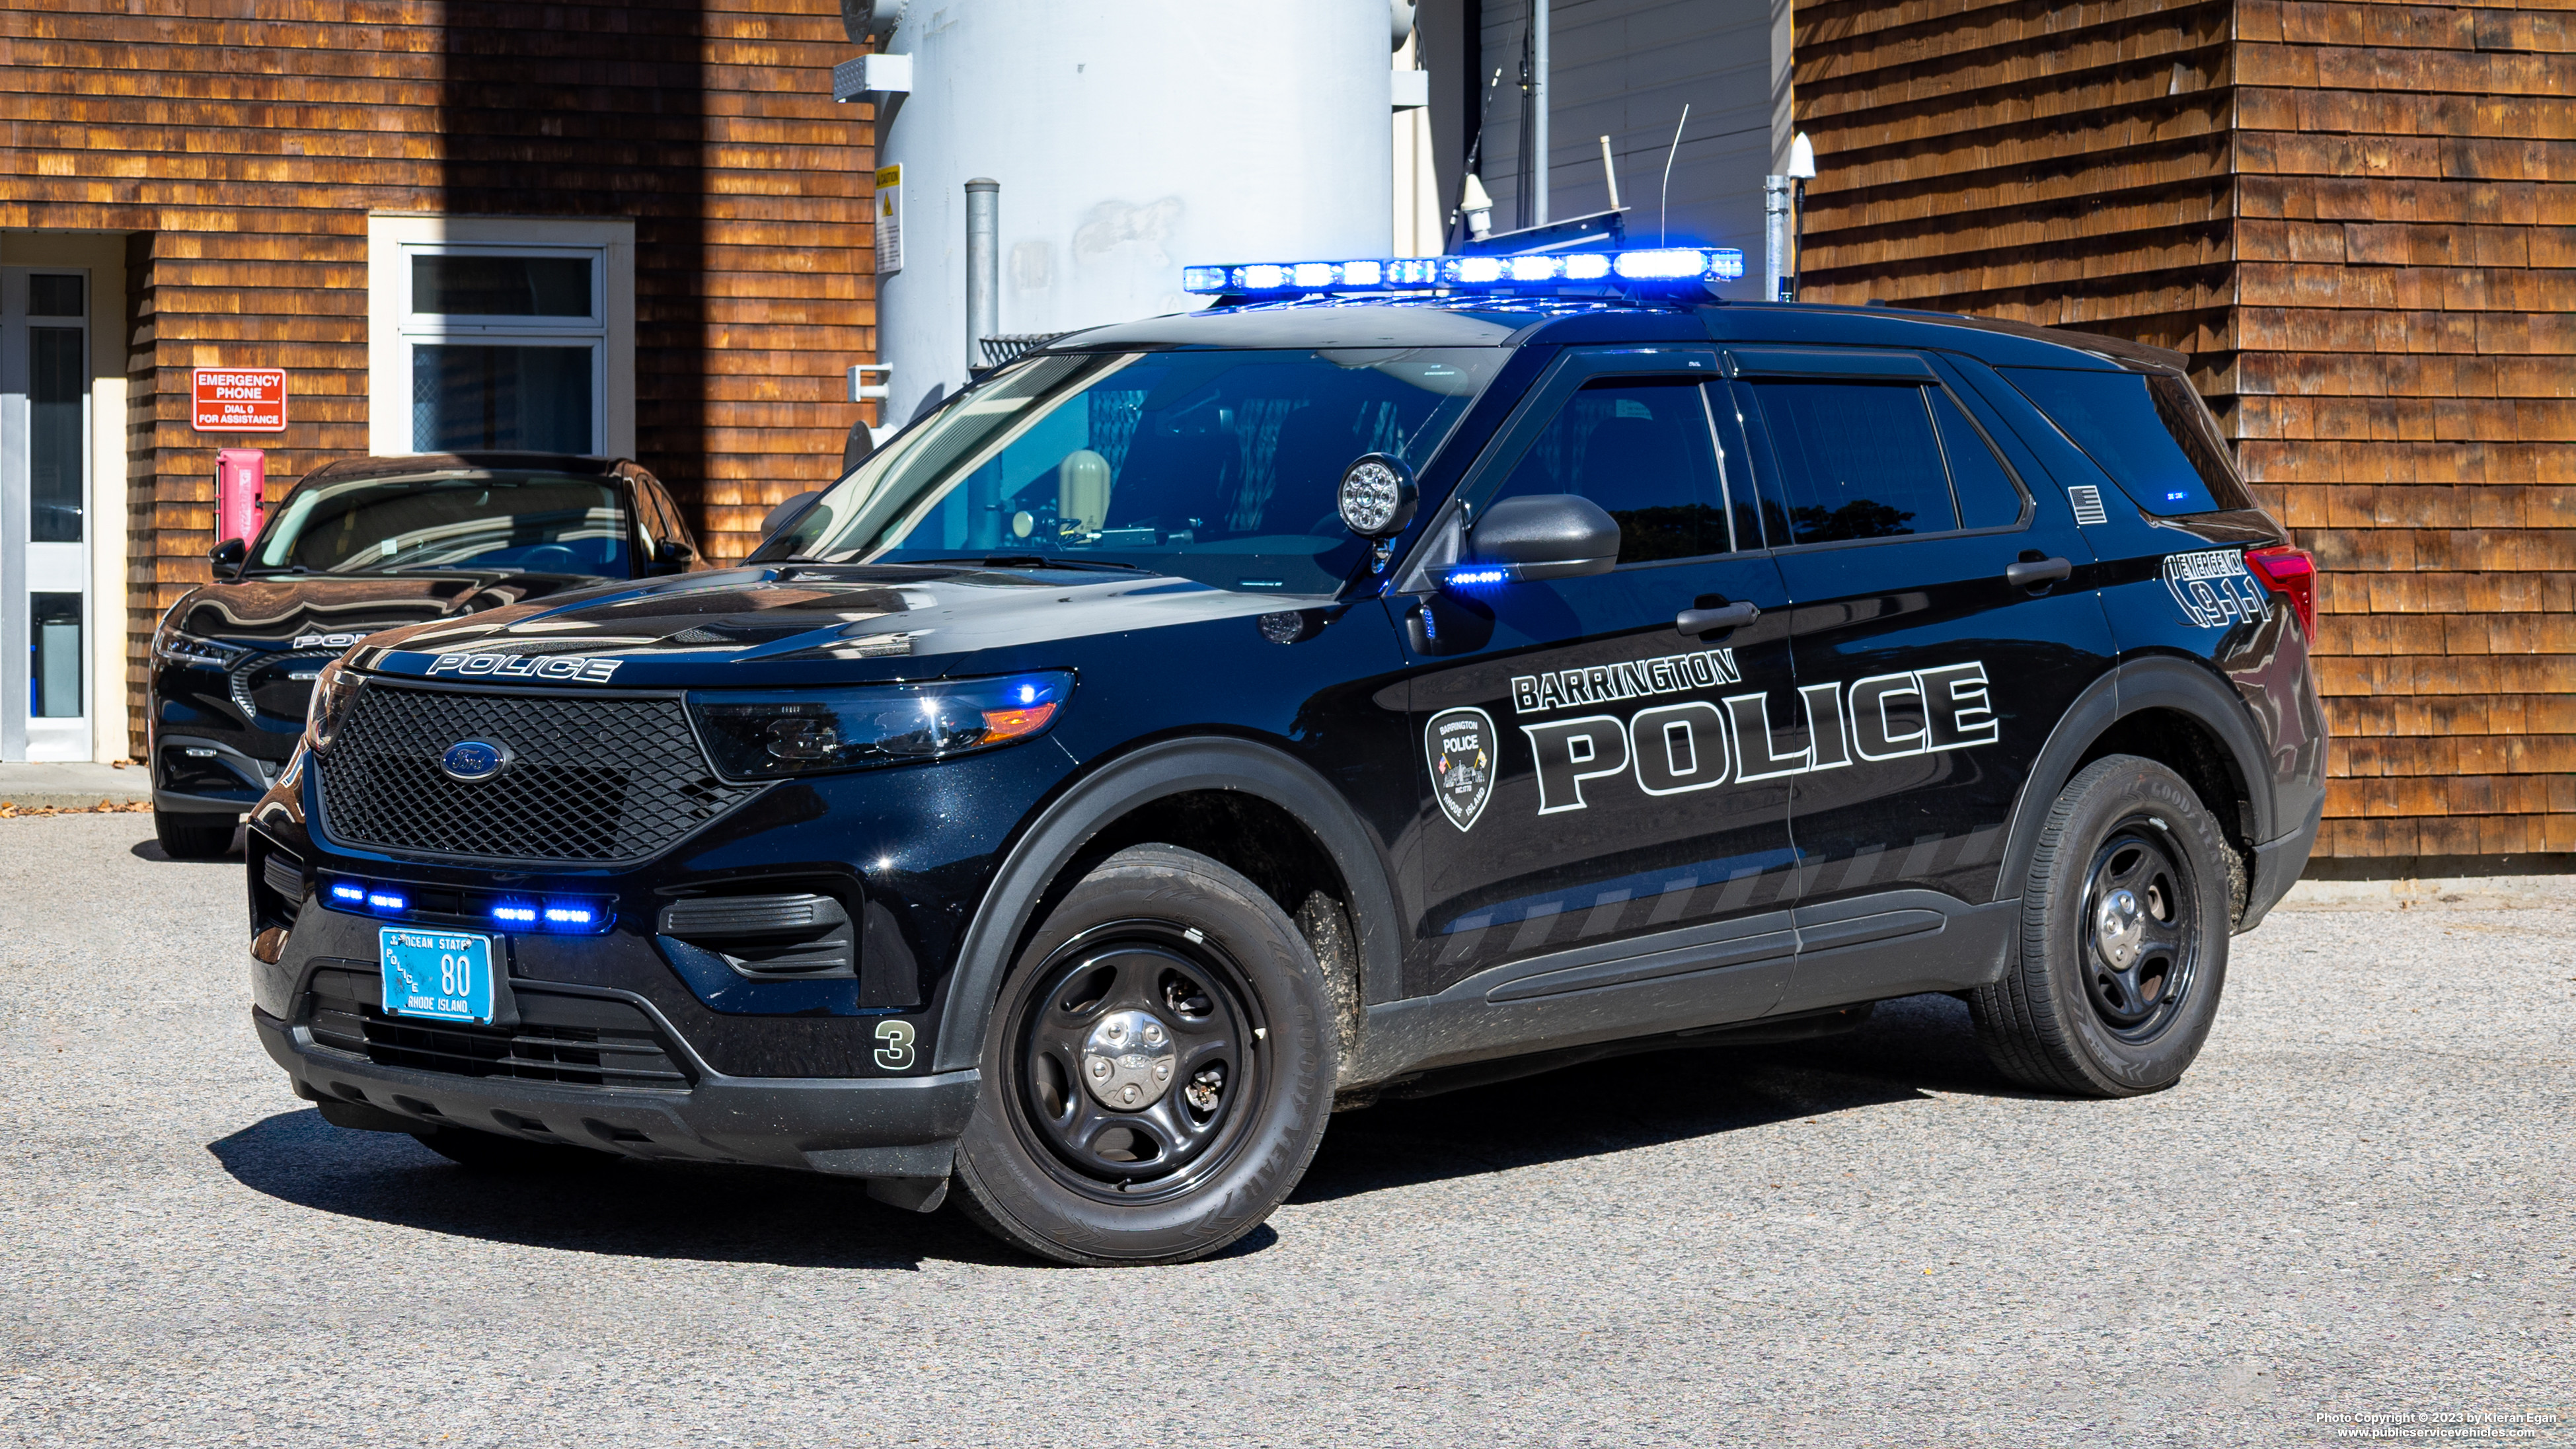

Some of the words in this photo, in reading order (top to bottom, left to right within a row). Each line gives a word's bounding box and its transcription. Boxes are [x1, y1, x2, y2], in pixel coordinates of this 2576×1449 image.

[198, 374, 280, 387] EMERGENCY
[216, 387, 262, 399] PHONE
[199, 414, 219, 424] FOR
[220, 415, 279, 424] ASSISTANCE
[225, 404, 246, 414] DIAL
[247, 405, 254, 414] 0
[2176, 549, 2247, 581] EMERGENCY
[425, 653, 624, 683] POLICE
[1511, 648, 1741, 714] BARRINGTON
[1439, 720, 1478, 735] BARRINGTON
[1519, 661, 1999, 815] POLICE
[1443, 735, 1479, 754] POLICE
[452, 748, 486, 770] Ford
[1443, 793, 1462, 817] RHODE
[1465, 787, 1486, 816] ISLAND
[404, 936, 434, 949] OCEAN
[386, 948, 418, 992] POLICE
[441, 953, 470, 997] 80
[407, 995, 434, 1010] RHODE
[437, 998, 468, 1013] ISLAND
[874, 1020, 915, 1070] 3
